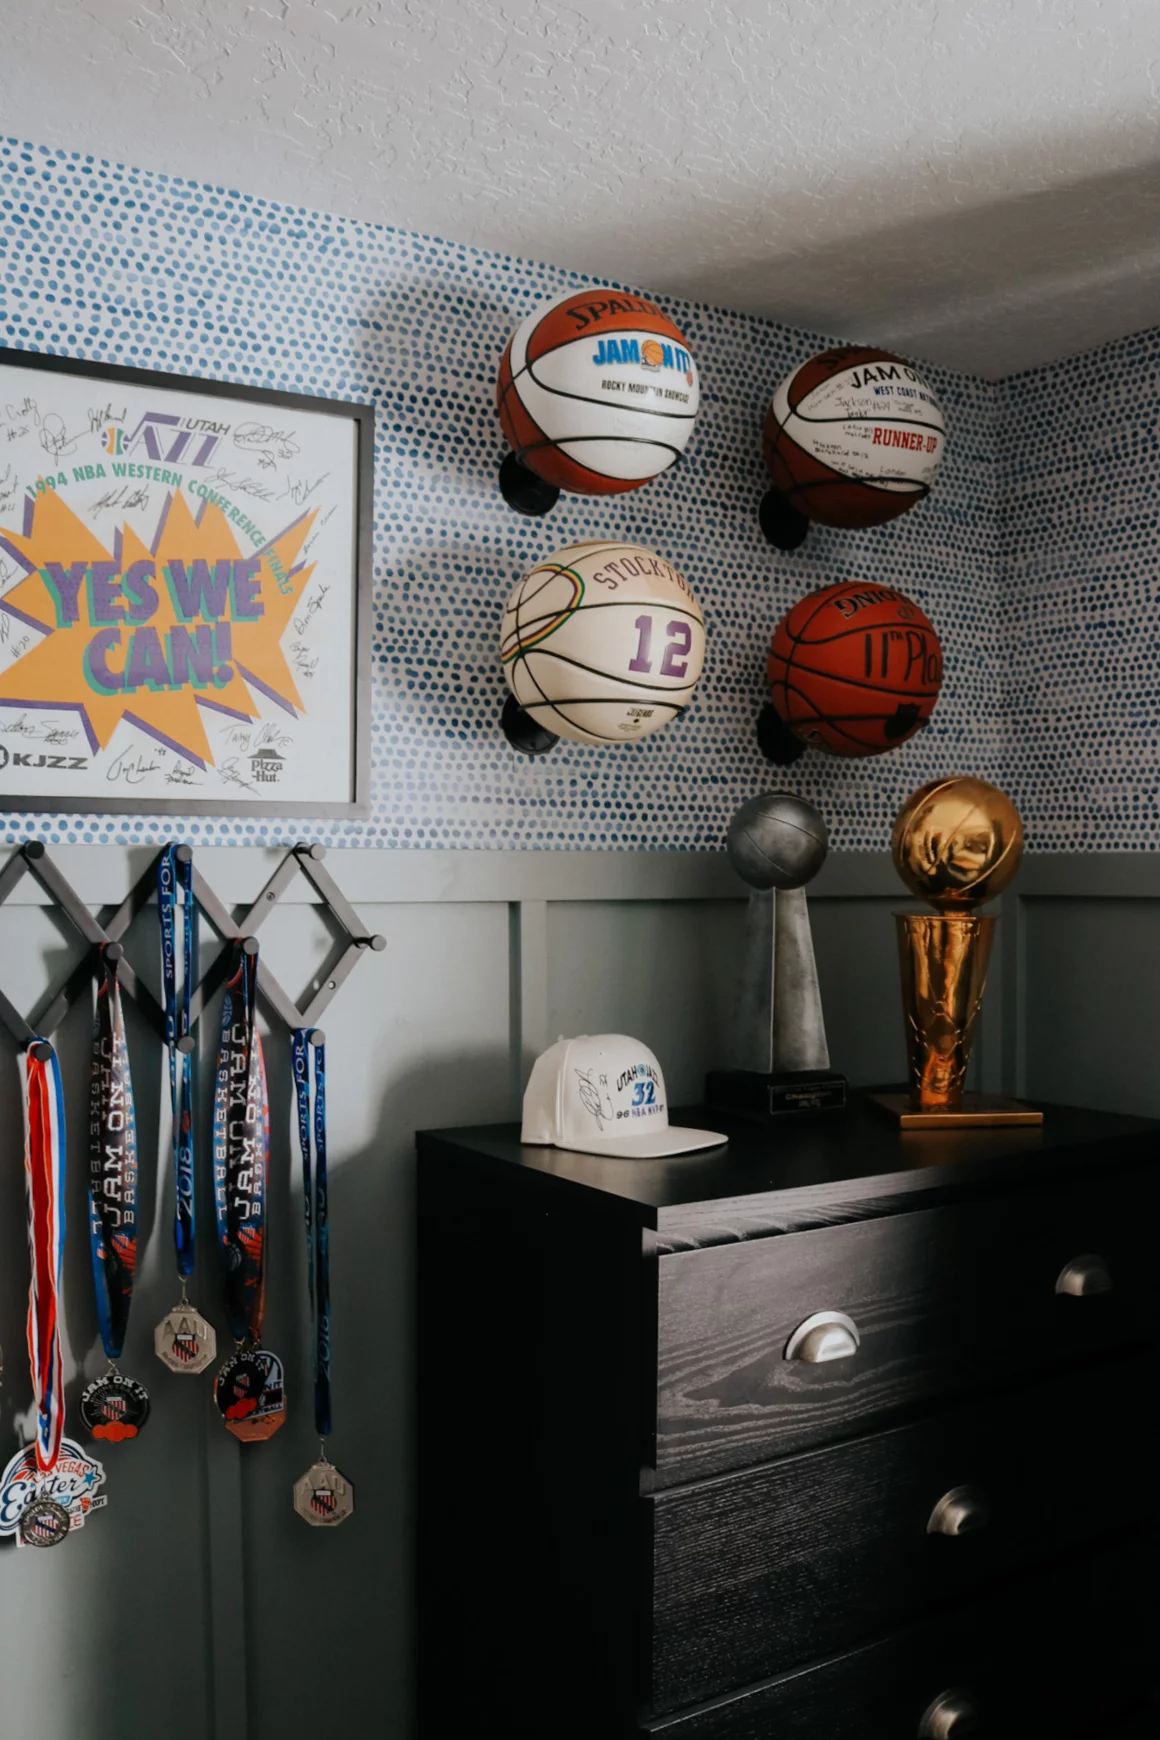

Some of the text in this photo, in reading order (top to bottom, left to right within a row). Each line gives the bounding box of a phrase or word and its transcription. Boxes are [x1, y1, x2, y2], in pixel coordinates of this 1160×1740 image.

[592, 339, 640, 367] JAM
[602, 379, 626, 392] ROCKY
[851, 365, 902, 389] JAM
[873, 386, 918, 400] WEST COAST
[186, 417, 232, 436] UTAH
[872, 427, 938, 455] RUNNER-UP
[26, 472, 69, 499] 1994
[72, 463, 107, 482] NBA
[111, 462, 184, 488] WESTERN
[187, 479, 267, 549] CONFERENCE
[262, 547, 294, 596] FINALS
[37, 559, 160, 629] YES
[161, 559, 265, 624] WE
[593, 556, 695, 604] STOCKTON
[82, 621, 234, 696] CAN!
[628, 614, 692, 679] 12
[12, 752, 89, 770] KJZZ
[160, 856, 173, 979] SPORTS FOR
[111, 1031, 122, 1068] IT
[229, 1023, 246, 1107] JAM
[315, 1048, 325, 1152] SPORTS FO
[616, 1064, 638, 1092] UTAH
[631, 1079, 657, 1107] 32
[106, 1080, 124, 1131] ON
[215, 1029, 230, 1221] BASKETBALL
[294, 1044, 309, 1161] SPORTS FOR
[234, 1138, 256, 1220] JAM
[246, 1074, 257, 1125] ON
[103, 1145, 123, 1227] JAM
[177, 1147, 193, 1221] 2018
[162, 1316, 207, 1341] AAU
[81, 1376, 110, 1402] JAM
[113, 1375, 135, 1388] ON
[134, 1386, 149, 1400] IT
[219, 1355, 239, 1386] JAM
[240, 1352, 255, 1362] ON
[56, 1461, 90, 1478] VEGAS
[0, 1476, 80, 1522] Eater
